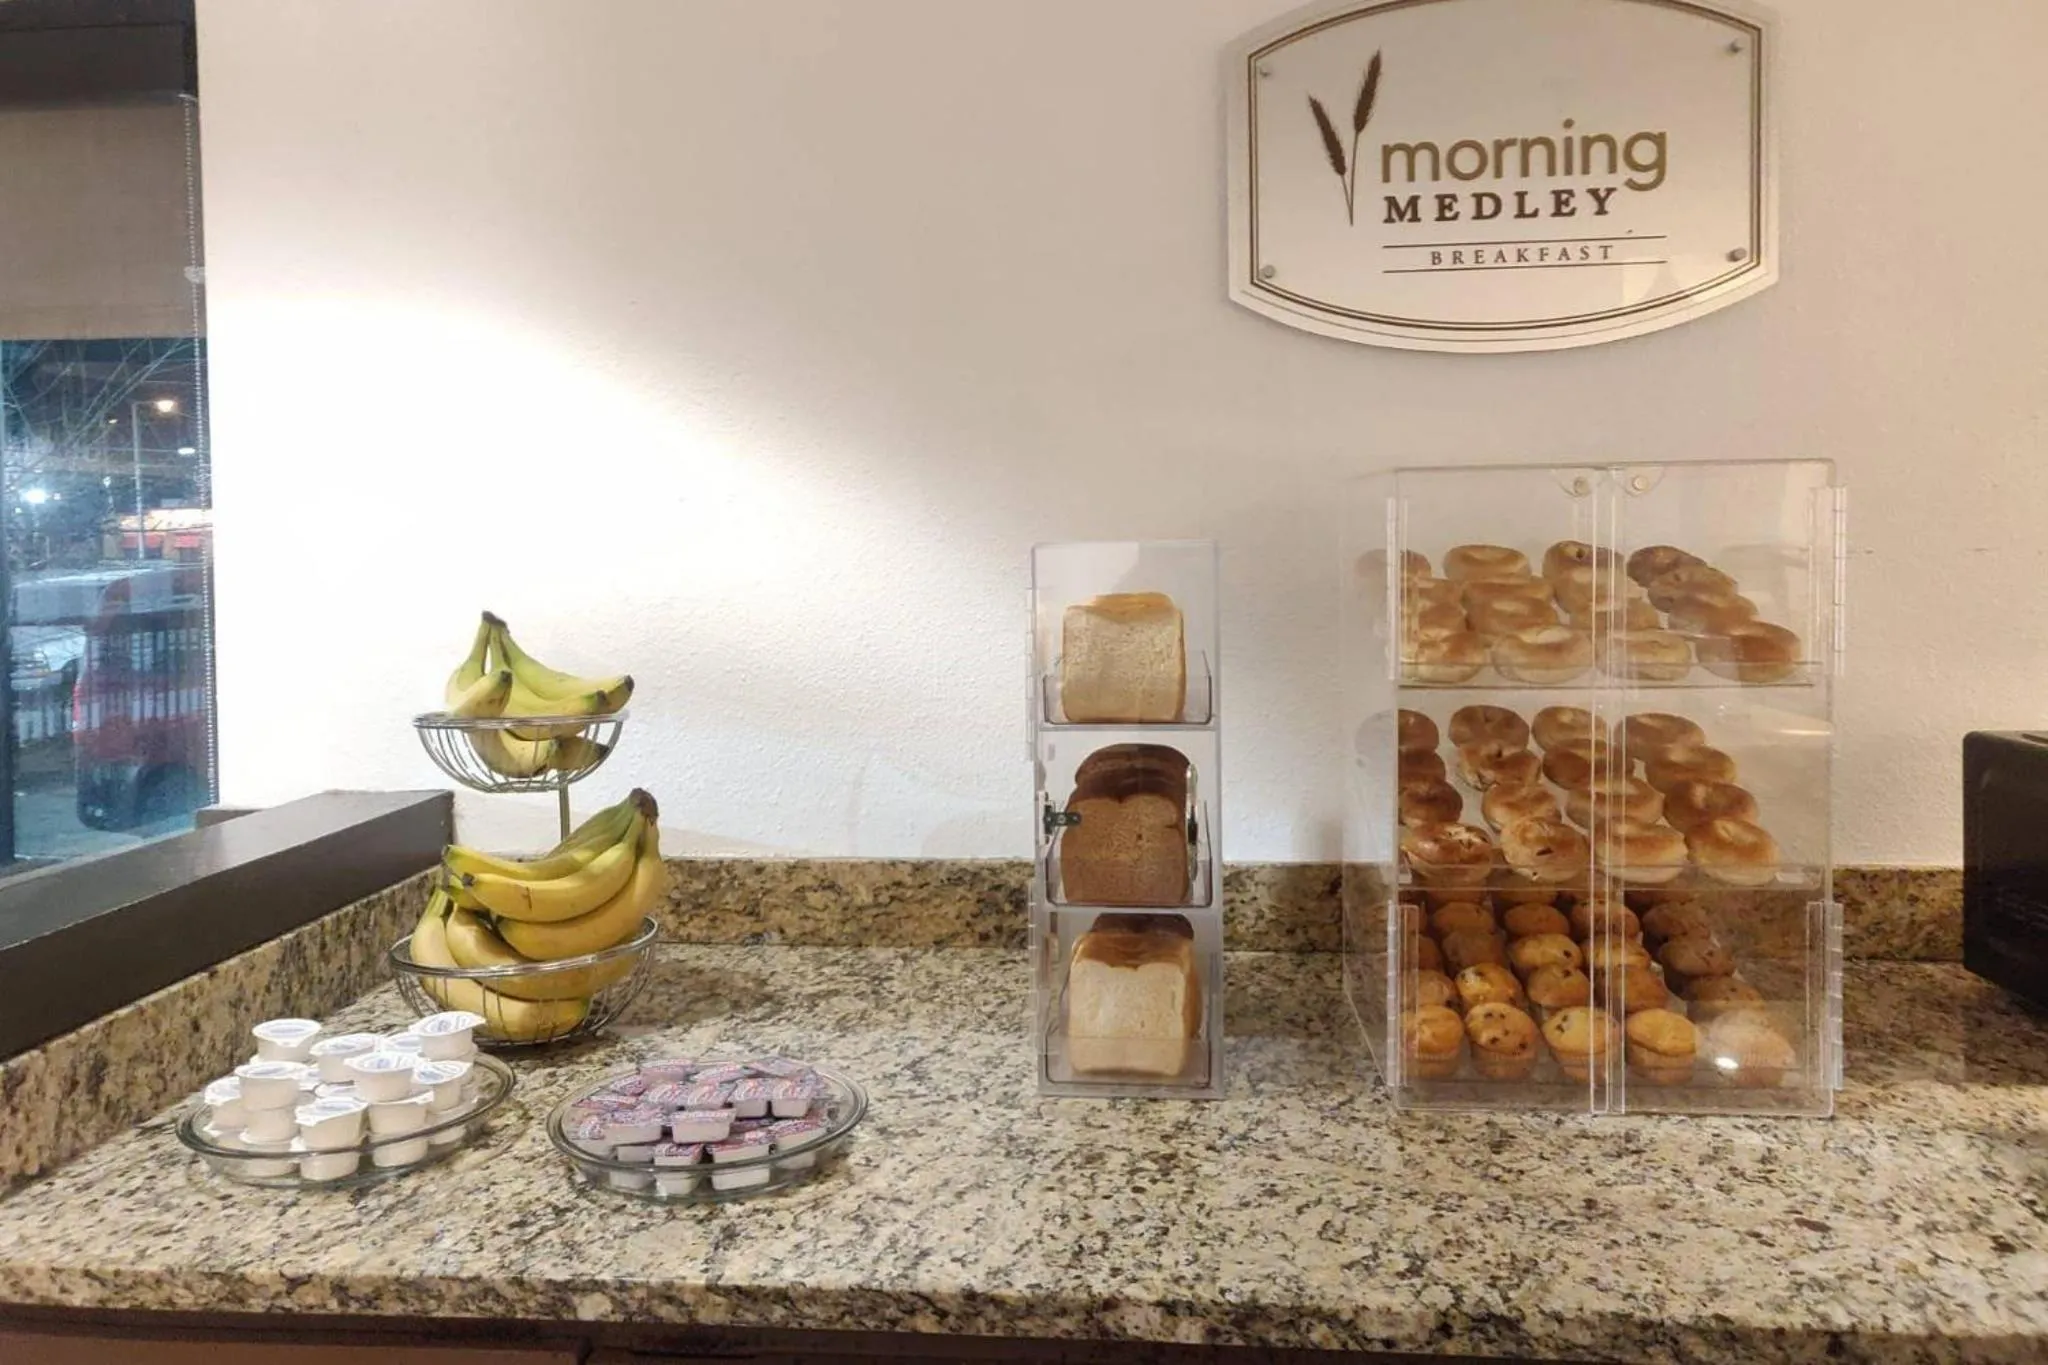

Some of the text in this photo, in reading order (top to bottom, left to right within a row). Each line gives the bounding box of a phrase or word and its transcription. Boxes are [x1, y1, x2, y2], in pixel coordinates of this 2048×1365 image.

[1382, 119, 1667, 191] morning
[1383, 188, 1618, 223] MEDLEY
[1431, 245, 1615, 266] BREAKFAST
